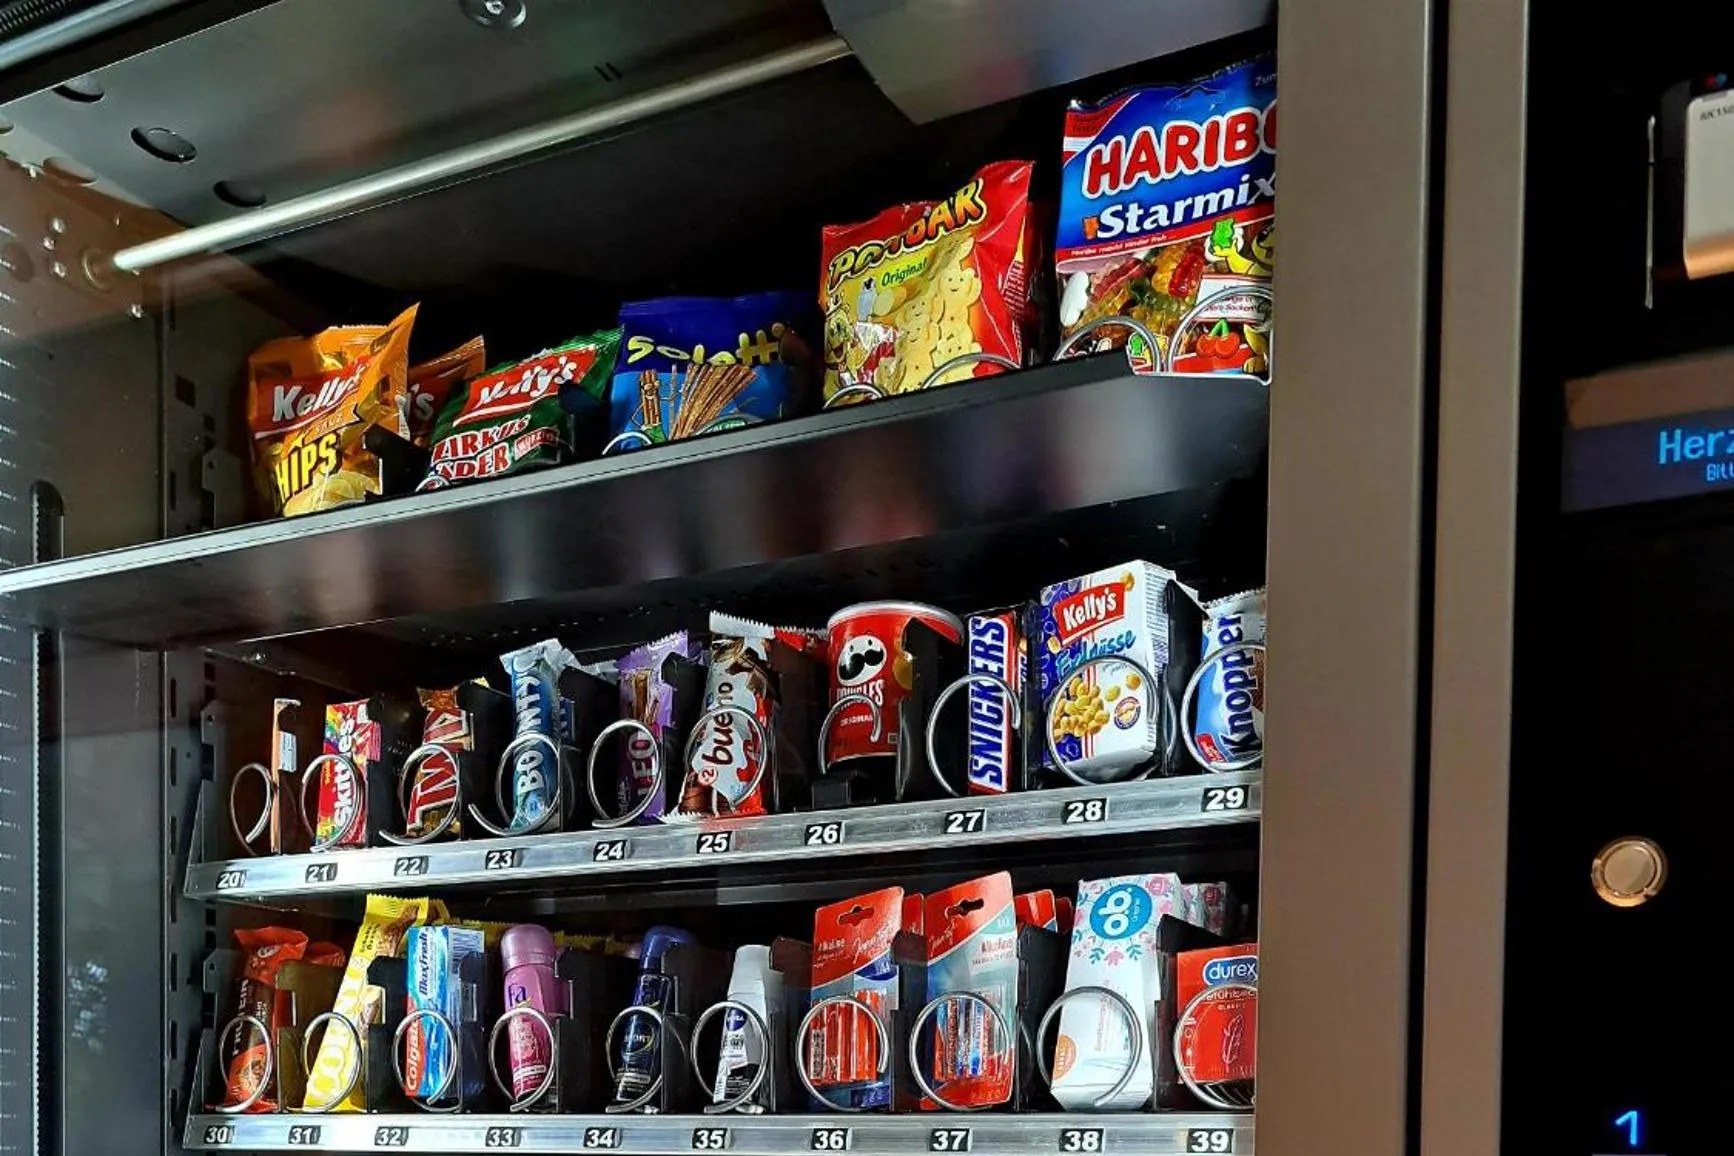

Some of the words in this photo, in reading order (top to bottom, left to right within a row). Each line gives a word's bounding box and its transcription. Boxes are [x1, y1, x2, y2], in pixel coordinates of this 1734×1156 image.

[1086, 110, 1276, 196] HARIB
[1097, 173, 1275, 239] Starmix
[1064, 587, 1117, 632] Kelly's
[1206, 788, 1244, 809] 29
[1067, 801, 1101, 822] 28
[947, 813, 980, 833] 27
[808, 825, 840, 843] 26
[596, 843, 624, 860] 24
[701, 835, 729, 851] 25
[397, 859, 421, 875] 22
[487, 853, 513, 868] 23
[218, 872, 240, 888] 20
[308, 866, 329, 881] 21
[1208, 962, 1256, 980] durex
[206, 1128, 227, 1142] 30
[290, 1128, 312, 1143] 31
[378, 1128, 400, 1143] 32
[1615, 1110, 1637, 1145] 1
[488, 1130, 513, 1145] 33
[587, 1129, 612, 1146] 34
[696, 1130, 723, 1147] 35
[815, 1131, 843, 1148] 36
[933, 1131, 967, 1149] 37
[1065, 1131, 1099, 1150] 38
[1192, 1131, 1229, 1150] 39
